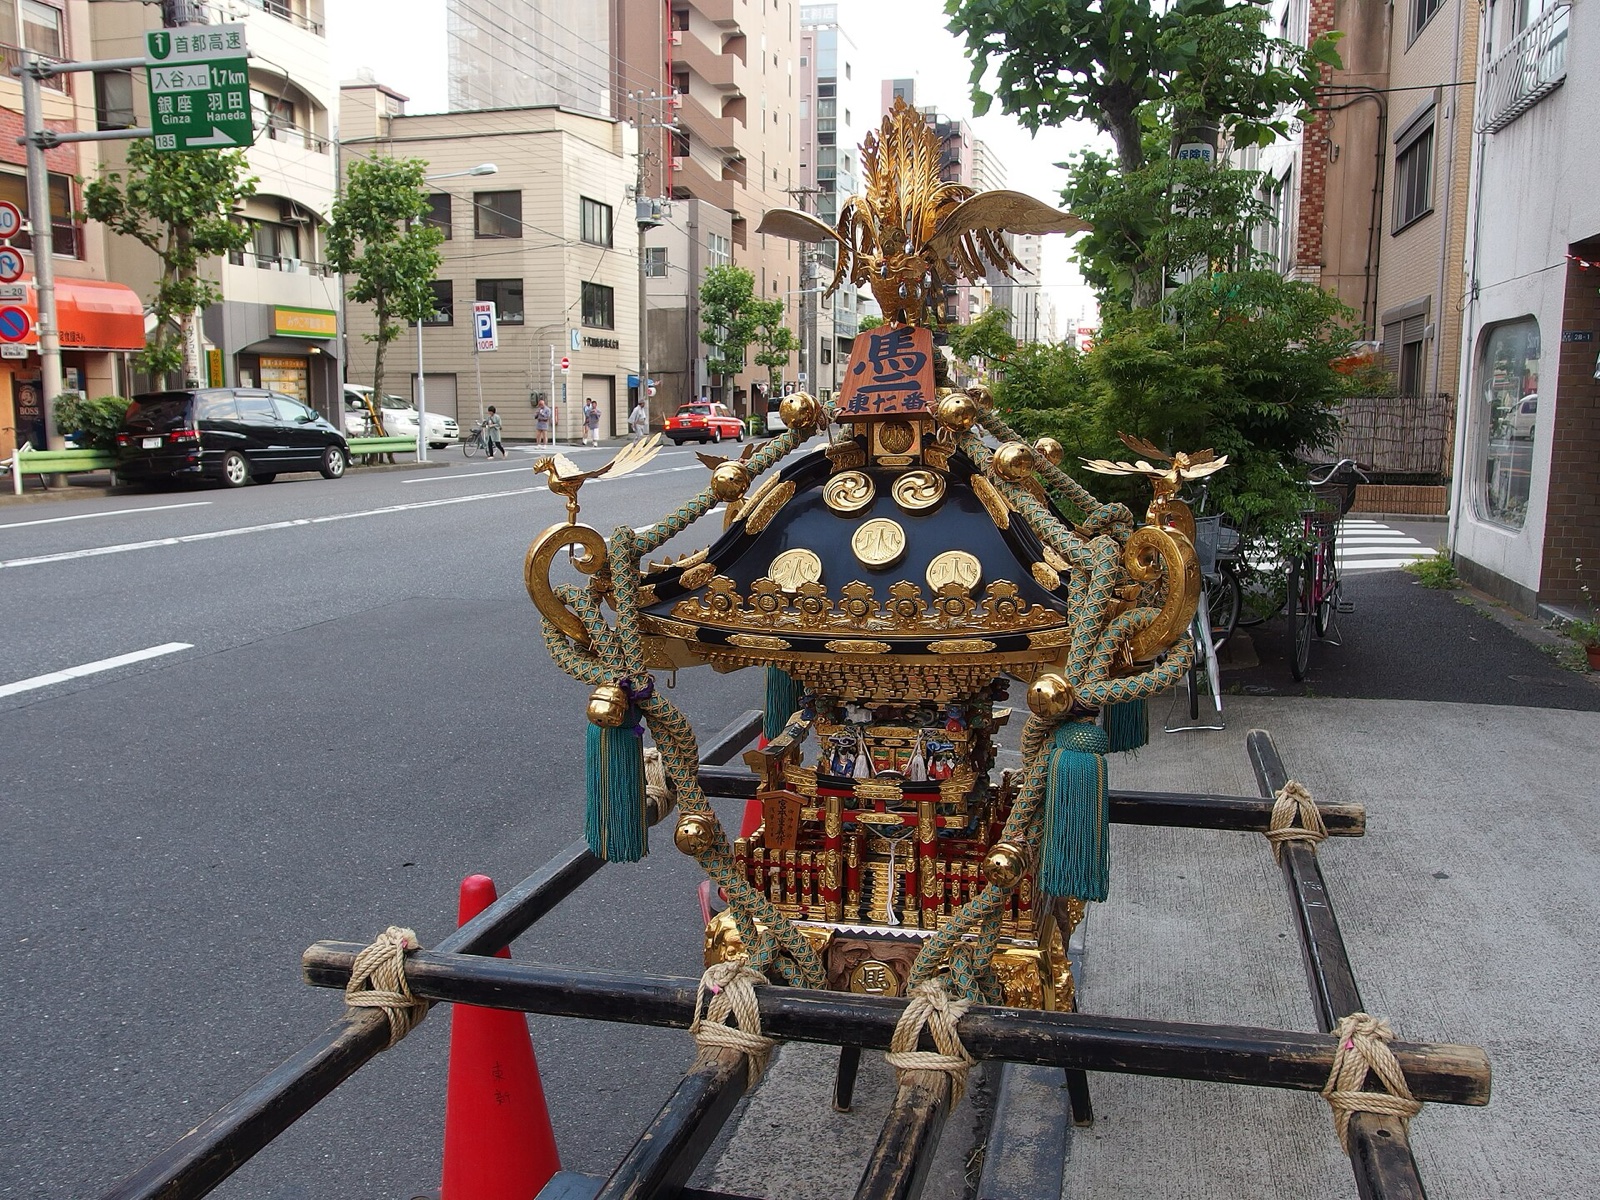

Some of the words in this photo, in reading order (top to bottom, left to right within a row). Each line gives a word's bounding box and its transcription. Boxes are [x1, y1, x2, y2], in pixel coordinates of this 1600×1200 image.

[175, 32, 241, 53] 首都高速
[157, 95, 192, 114] 銀座
[208, 92, 243, 110] 羽田
[162, 115, 190, 124] Ginza
[207, 111, 246, 121] Haneda
[157, 136, 175, 147] 185
[0, 212, 13, 227] 0
[478, 315, 491, 338] P
[20, 406, 39, 415] BOSS
